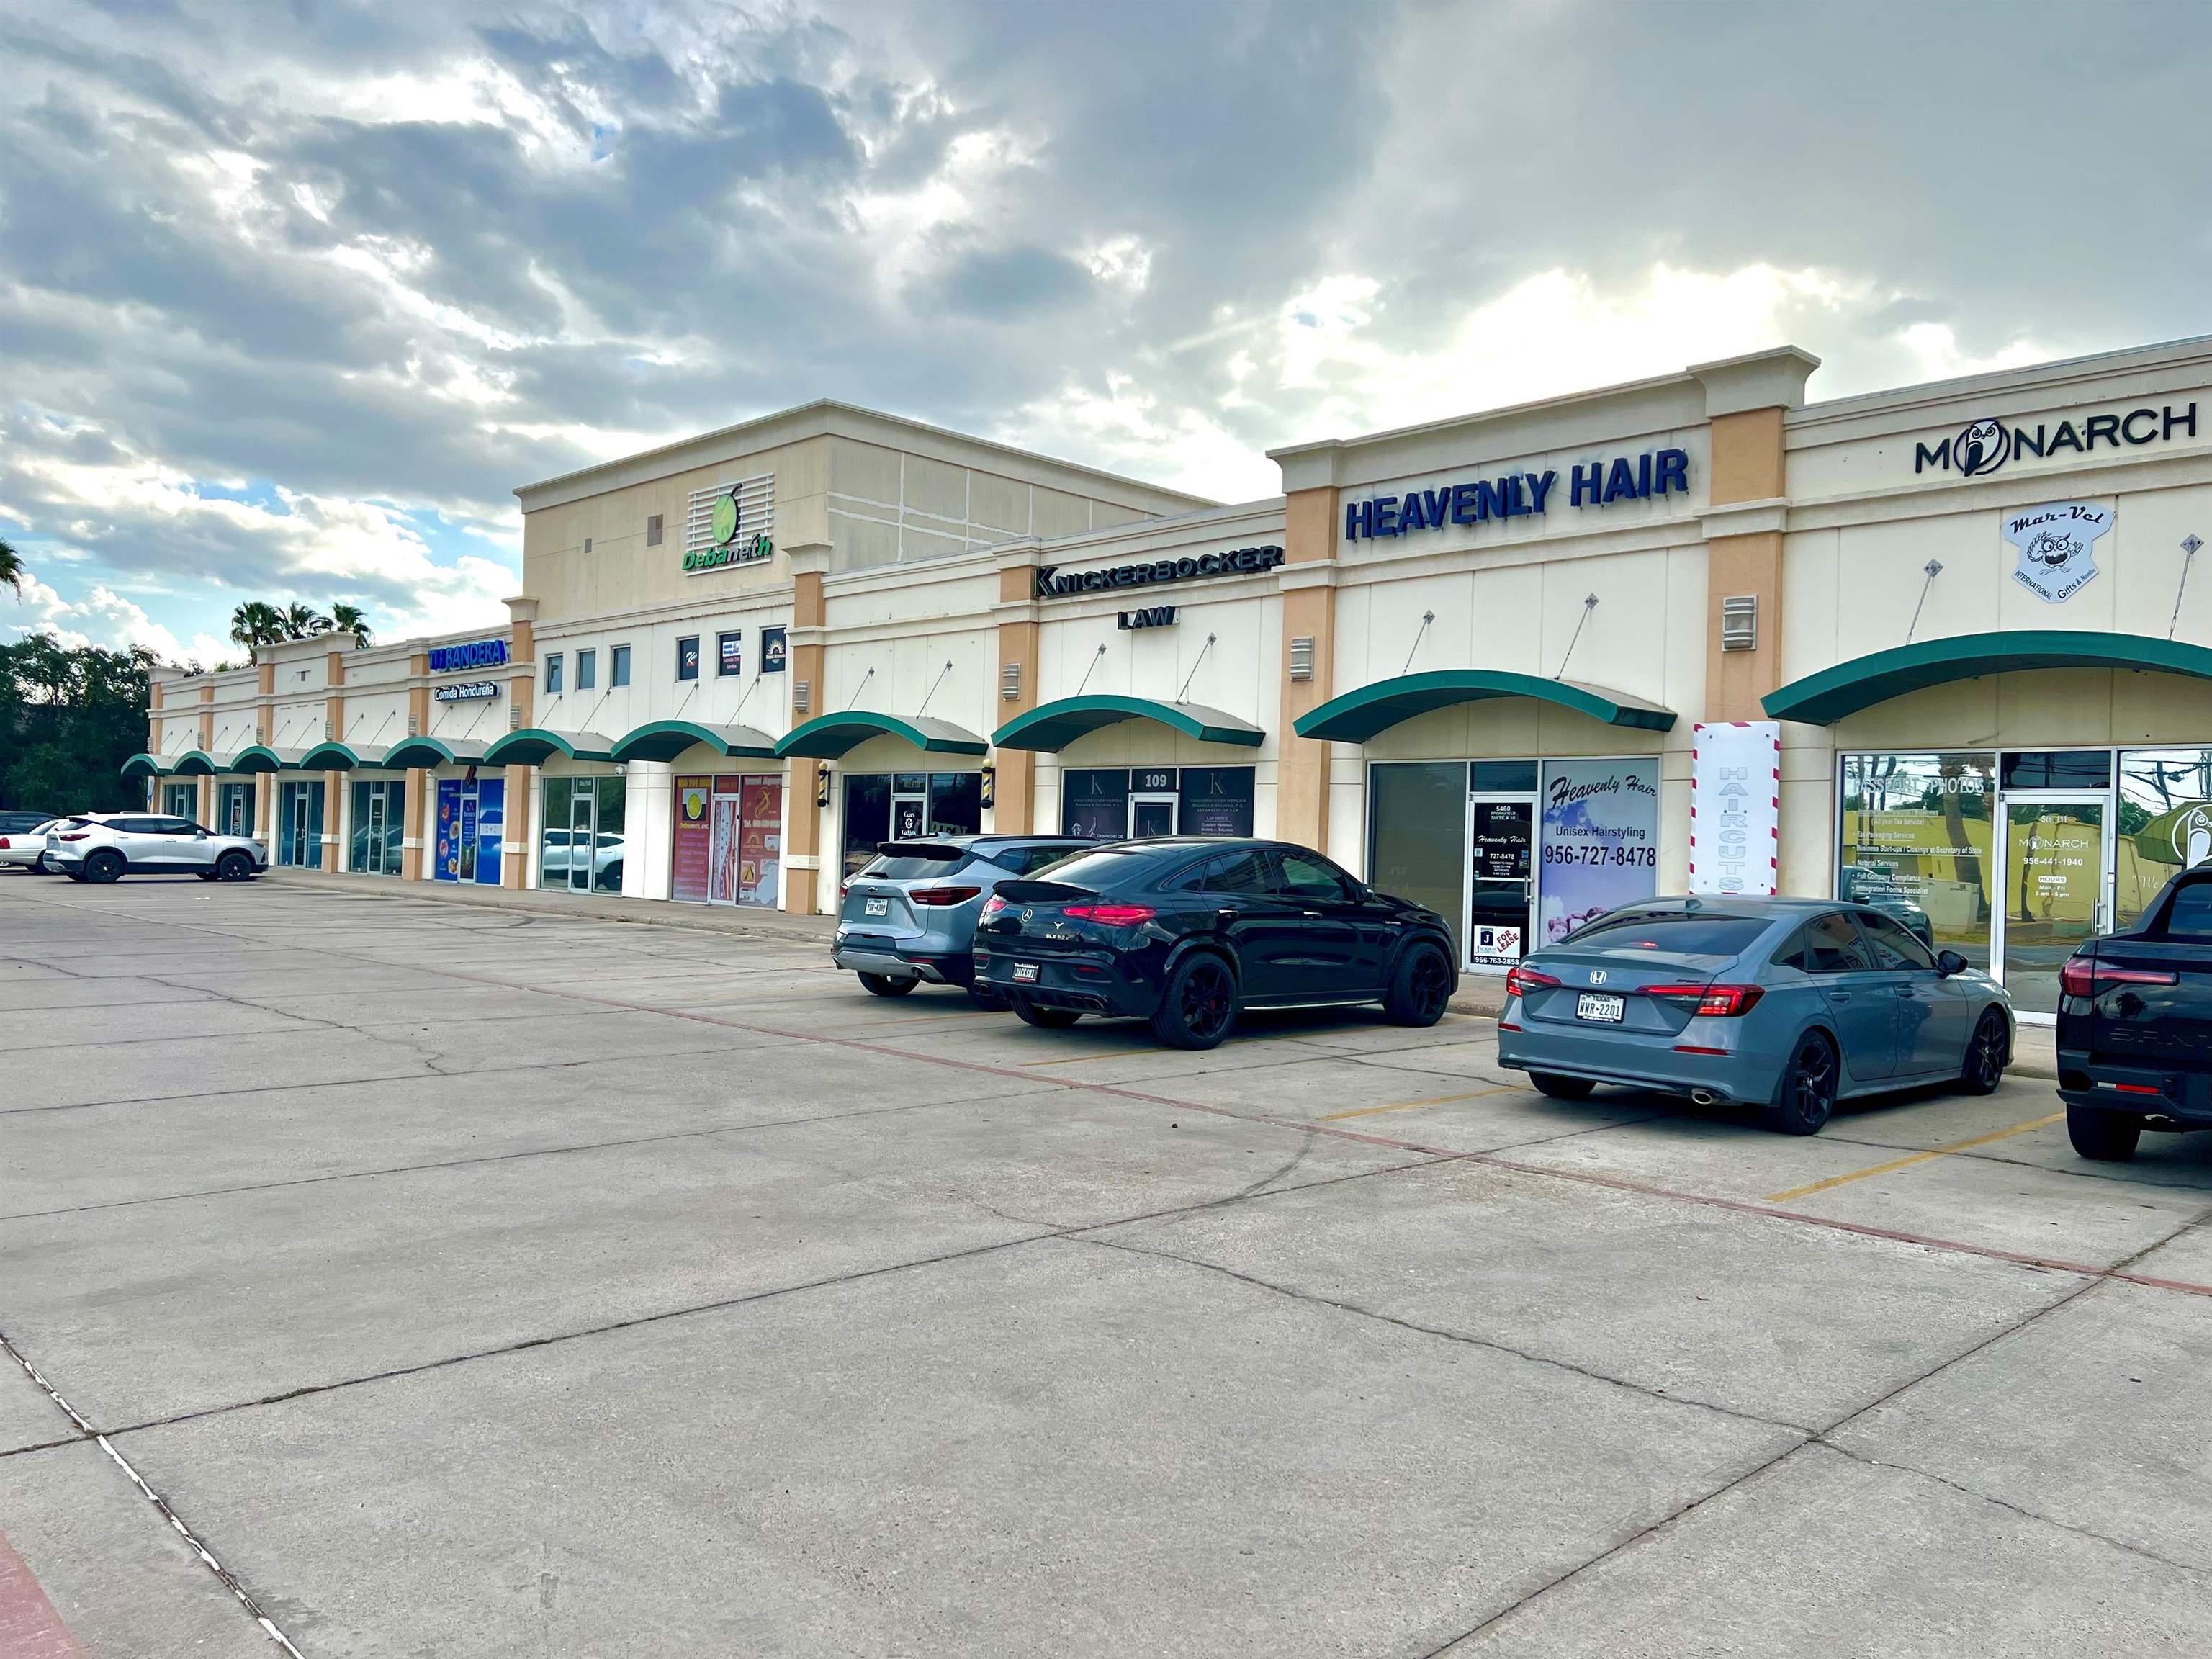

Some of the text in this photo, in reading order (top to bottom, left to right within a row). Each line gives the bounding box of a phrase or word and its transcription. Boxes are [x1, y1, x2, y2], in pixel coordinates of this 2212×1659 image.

[1915, 402, 2198, 477] MONARCH
[1346, 448, 1689, 541] HEAVENLY HAIR
[2010, 506, 2104, 534] Mar-Vel
[682, 533, 773, 570] Debaneth
[1033, 545, 1285, 597] KNICKERBOCKER
[2015, 570, 2053, 601] INTERNATIONAL
[2057, 582, 2077, 599] Gifts
[1118, 606, 1177, 630] LAW
[446, 639, 505, 668] BANDERA
[435, 683, 494, 701] Comida Hondureña
[1146, 774, 1167, 788] 109
[1854, 777, 1984, 794] PASSPORT PHOTOS
[1550, 775, 1657, 809] Heavenly Hair
[1556, 826, 1646, 840] Unisex Hairstyling
[1718, 767, 1749, 891] HAIRCUTS
[1478, 835, 1508, 844] Heavenly
[2018, 836, 2089, 850] MONARCH
[1545, 845, 1656, 867] 956-727-8478
[1936, 846, 1961, 855] Secretary
[1867, 873, 1890, 881] Company
[1891, 873, 1921, 882] Compliance
[1497, 930, 1511, 944] FOR
[1497, 933, 1519, 953] LEASE
[1475, 956, 1519, 966] 956-763-2858
